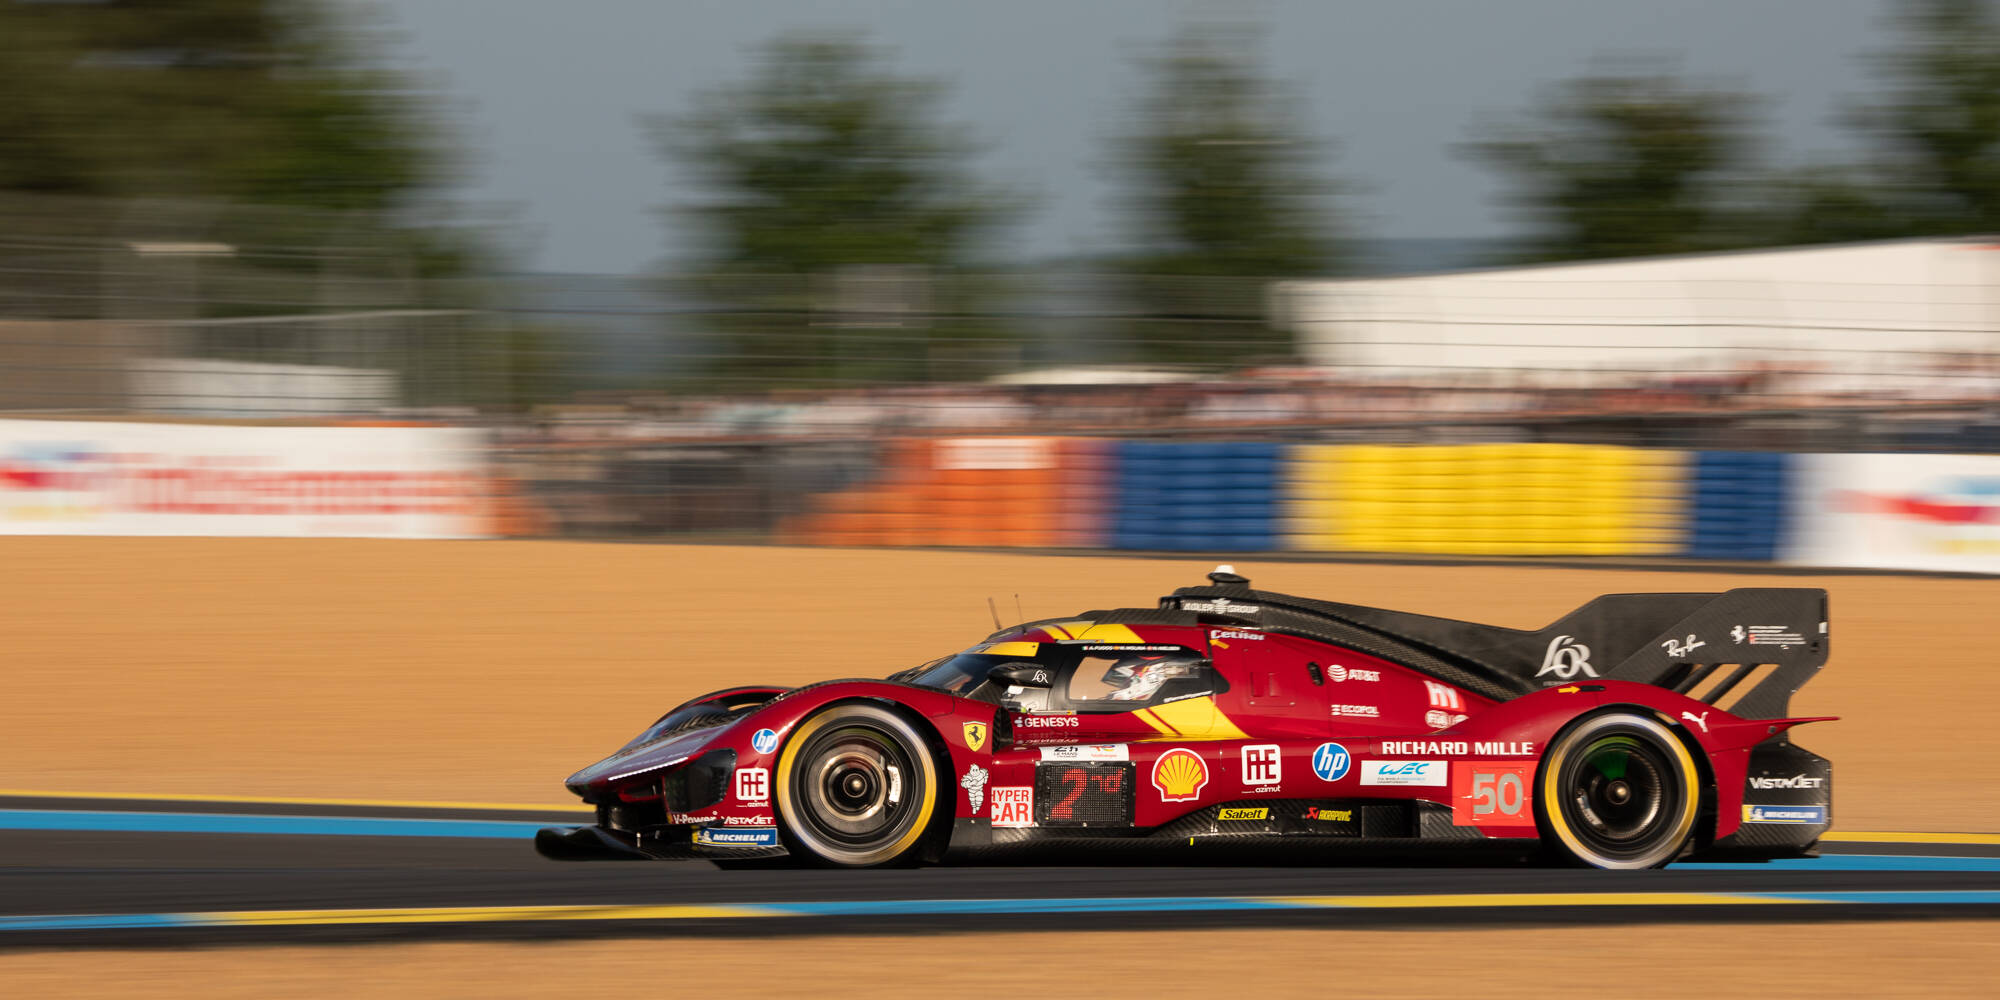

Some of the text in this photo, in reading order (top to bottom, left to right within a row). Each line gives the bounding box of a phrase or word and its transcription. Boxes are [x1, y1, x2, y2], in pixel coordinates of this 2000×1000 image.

[1024, 717, 1079, 728] GENESYS
[755, 729, 777, 754] hp
[1381, 741, 1534, 756] RICHARD MILLE
[1317, 743, 1347, 781] hp
[1378, 762, 1431, 776] WEC
[991, 789, 1029, 802] HYPER
[1255, 784, 1281, 793] azimut
[1473, 773, 1524, 816] 50
[991, 802, 1029, 823] CAR
[1223, 809, 1263, 819] Sabelt
[712, 833, 770, 842] MICHELIN
